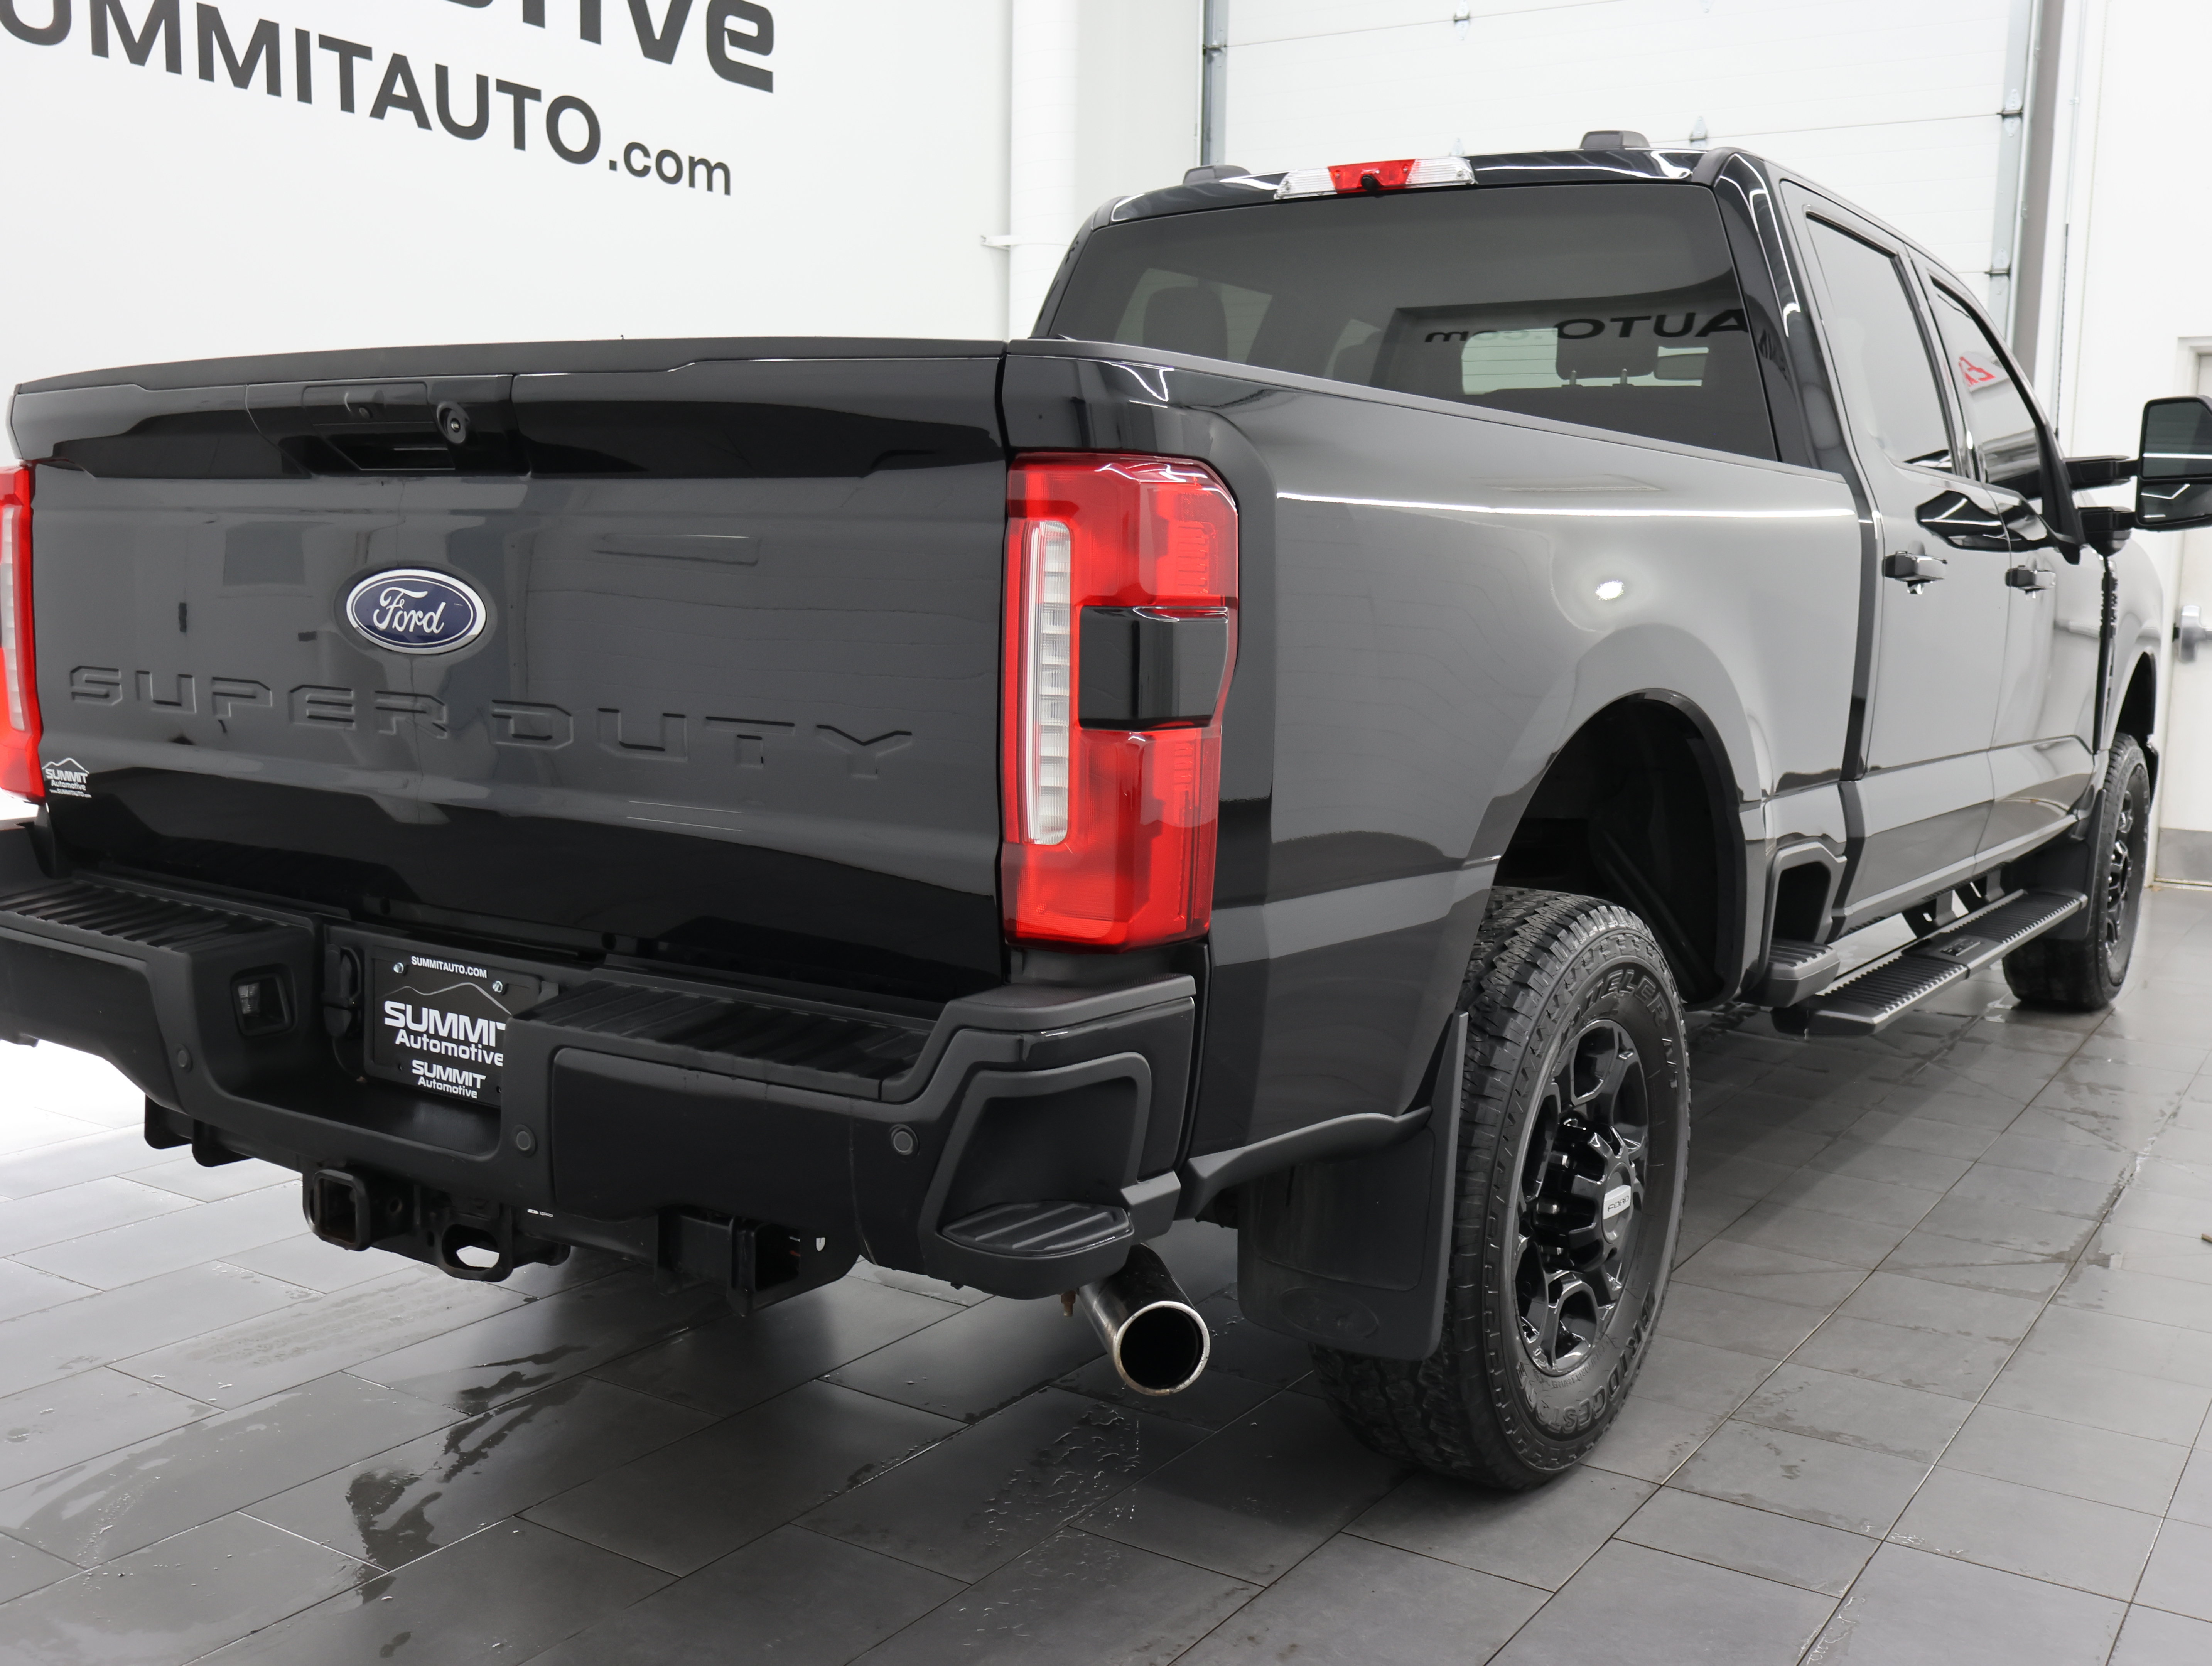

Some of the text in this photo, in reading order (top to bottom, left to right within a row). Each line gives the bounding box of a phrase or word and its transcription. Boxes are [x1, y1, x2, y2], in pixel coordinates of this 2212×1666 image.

[373, 587, 446, 634] Ford
[69, 664, 913, 780] SUPER DUTY
[45, 769, 88, 784] SUMMIT
[51, 780, 86, 791] Automotive
[411, 956, 487, 979] SUMMITAUTO.COM
[385, 1000, 506, 1047] SUMMI
[395, 1029, 503, 1067] Automotive
[412, 1059, 486, 1089] SUMMIT
[418, 1076, 478, 1099] Automotive
[1607, 1195, 1630, 1212] FORD
